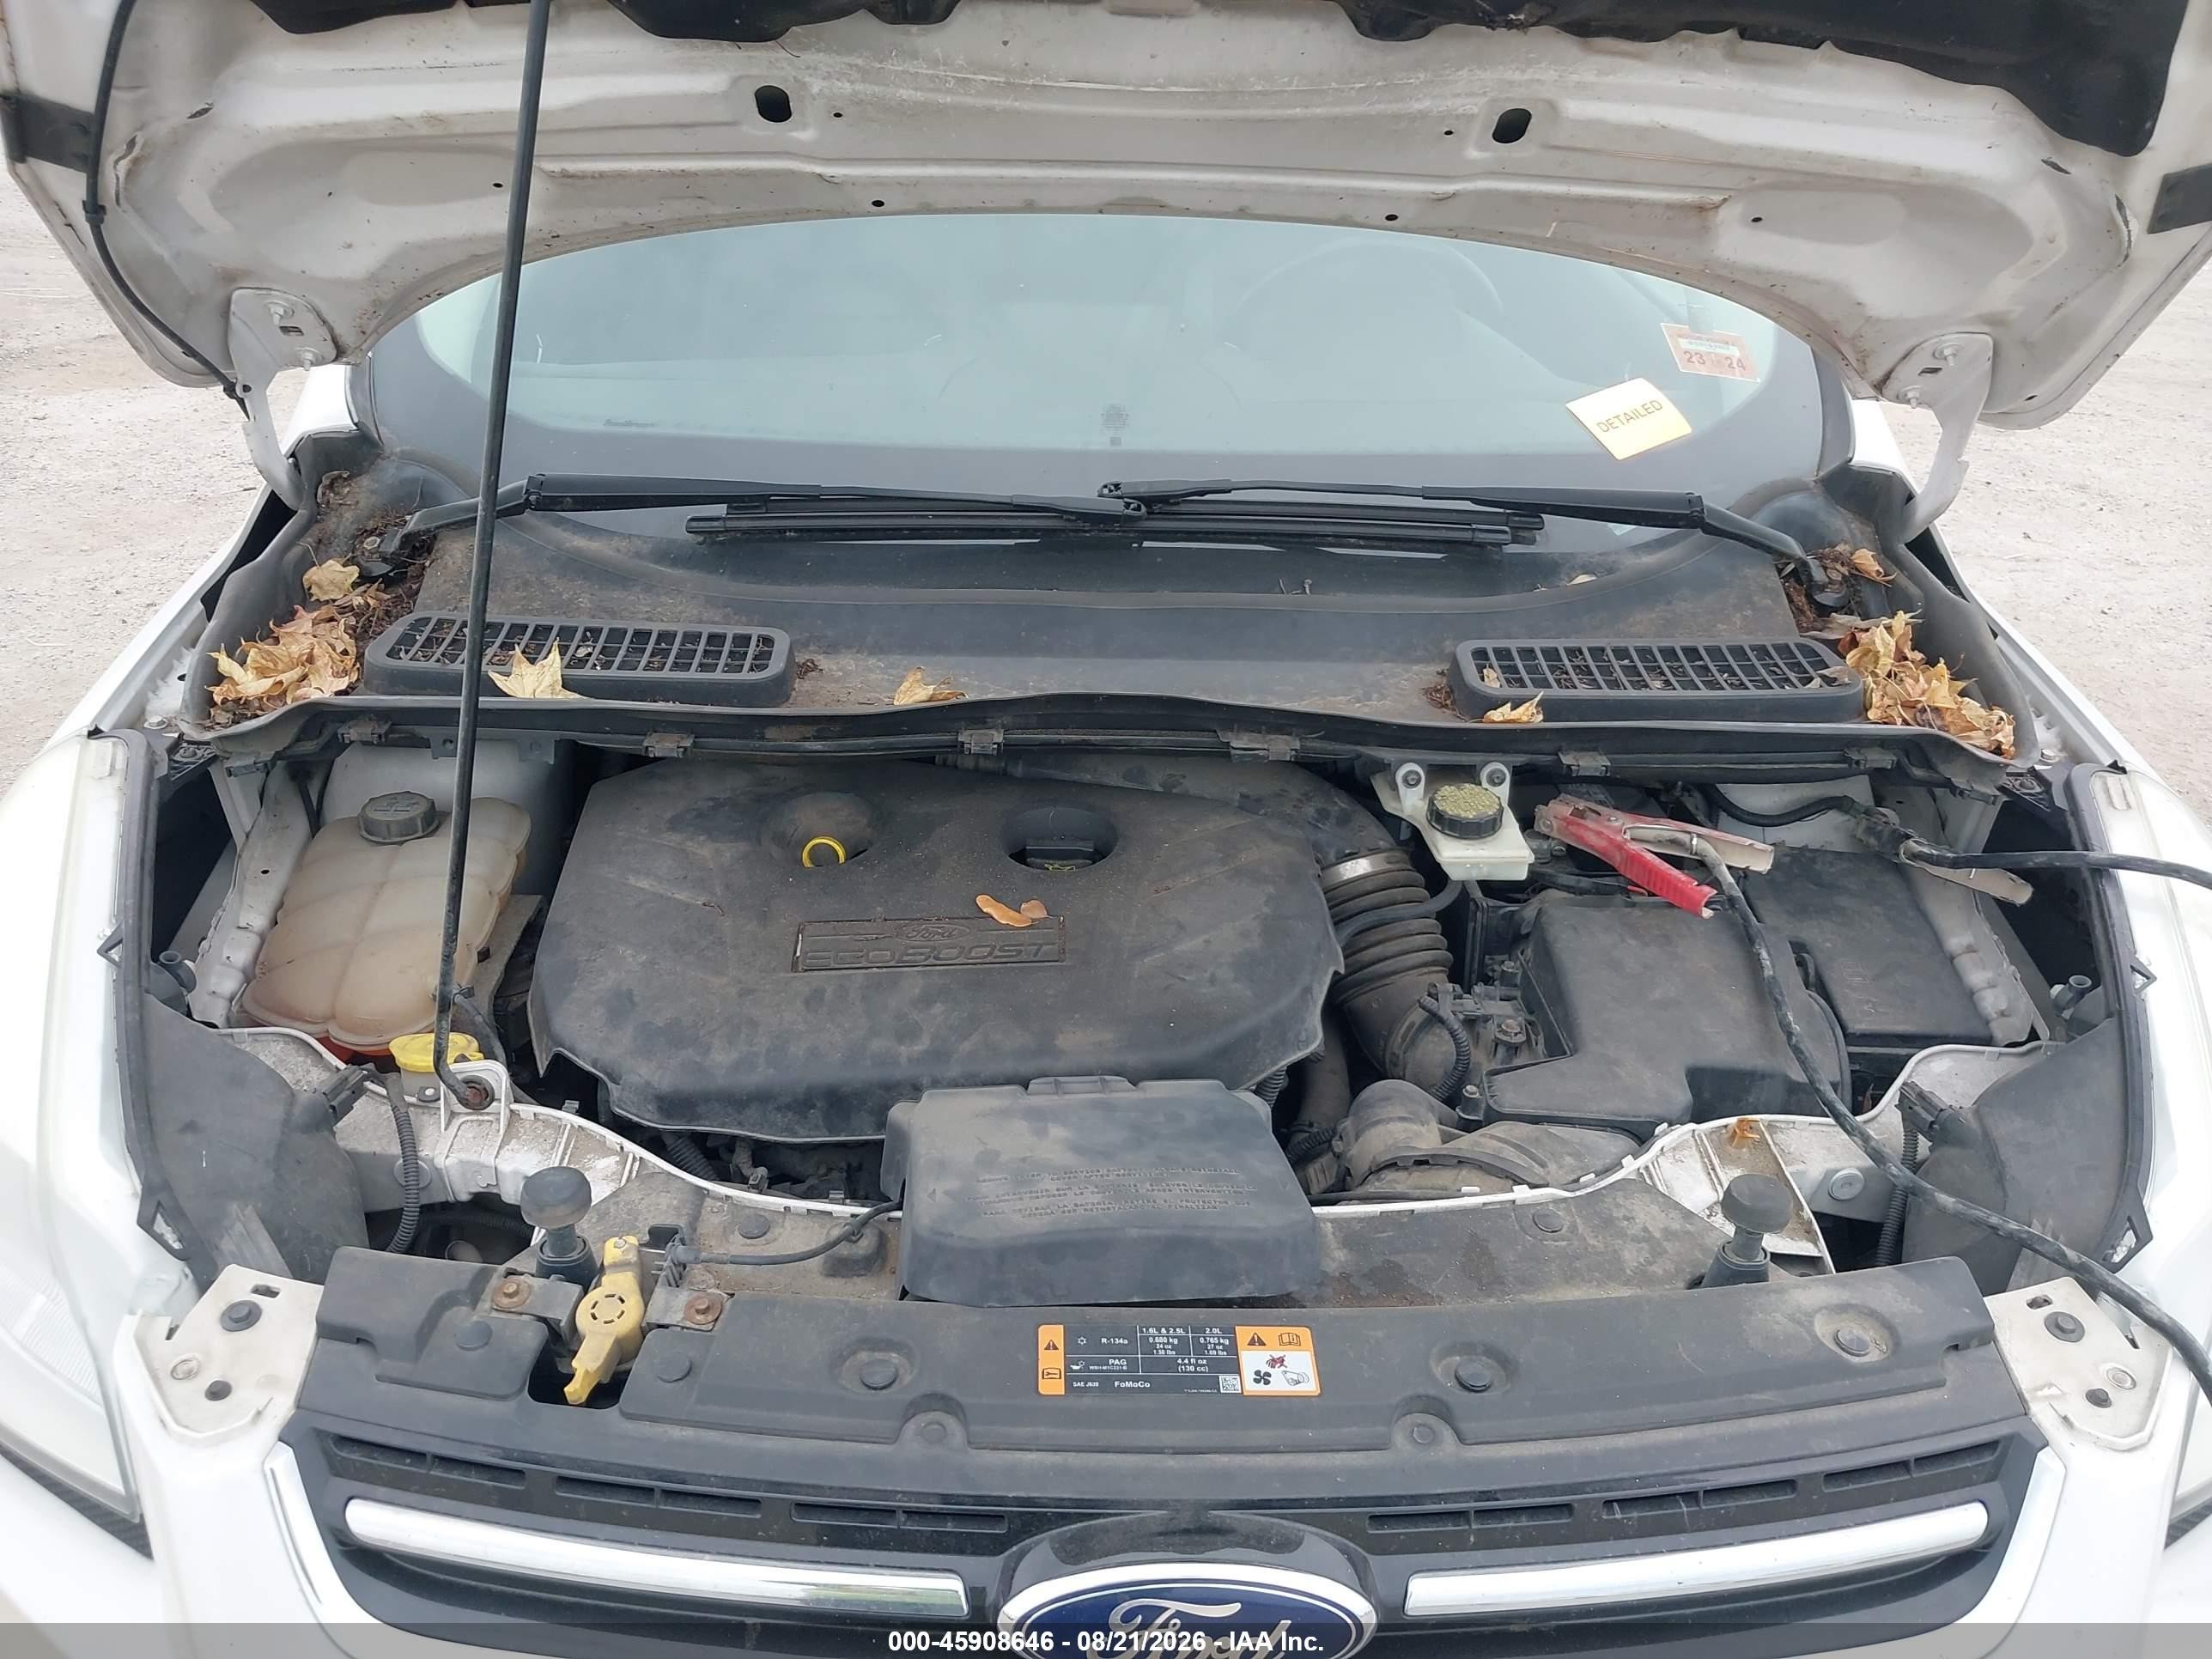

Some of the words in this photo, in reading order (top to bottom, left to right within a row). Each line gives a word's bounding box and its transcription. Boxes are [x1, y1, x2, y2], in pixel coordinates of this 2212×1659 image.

[1683, 350, 1706, 365] 23
[1724, 357, 1746, 370] 24
[1596, 399, 1663, 433] DETAILED
[905, 925, 958, 939] Ford
[803, 943, 1059, 968] ECOBOOST
